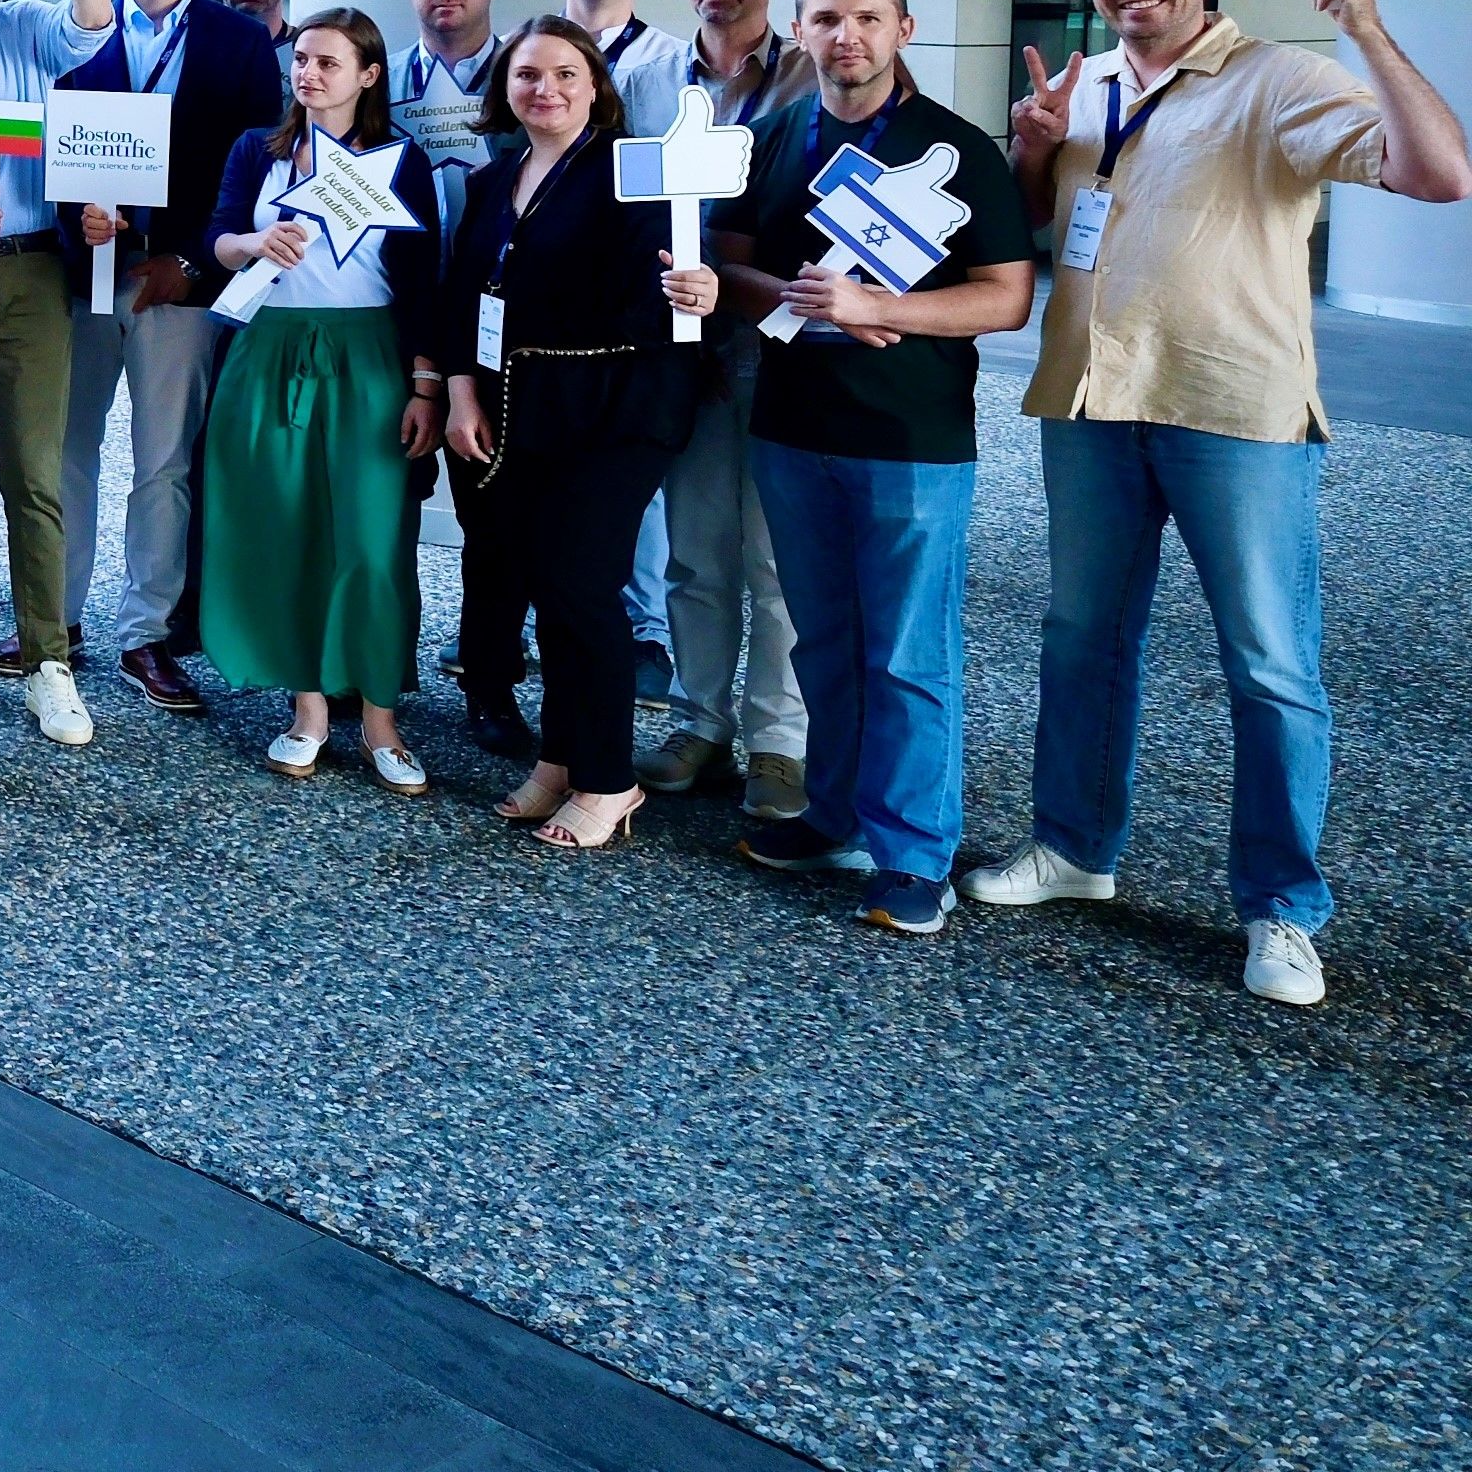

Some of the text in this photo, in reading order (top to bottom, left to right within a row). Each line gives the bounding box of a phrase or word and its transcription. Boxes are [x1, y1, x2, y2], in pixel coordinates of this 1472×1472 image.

[72, 124, 132, 143] Boston
[418, 121, 468, 135] Excellen
[57, 135, 156, 159] Scientific
[420, 136, 478, 149] Academy
[51, 159, 96, 170] Advancing
[98, 162, 129, 170] science
[131, 163, 143, 171] for
[328, 150, 396, 214] Endovascular
[323, 172, 372, 218] Excellence
[310, 184, 360, 231] Academy
